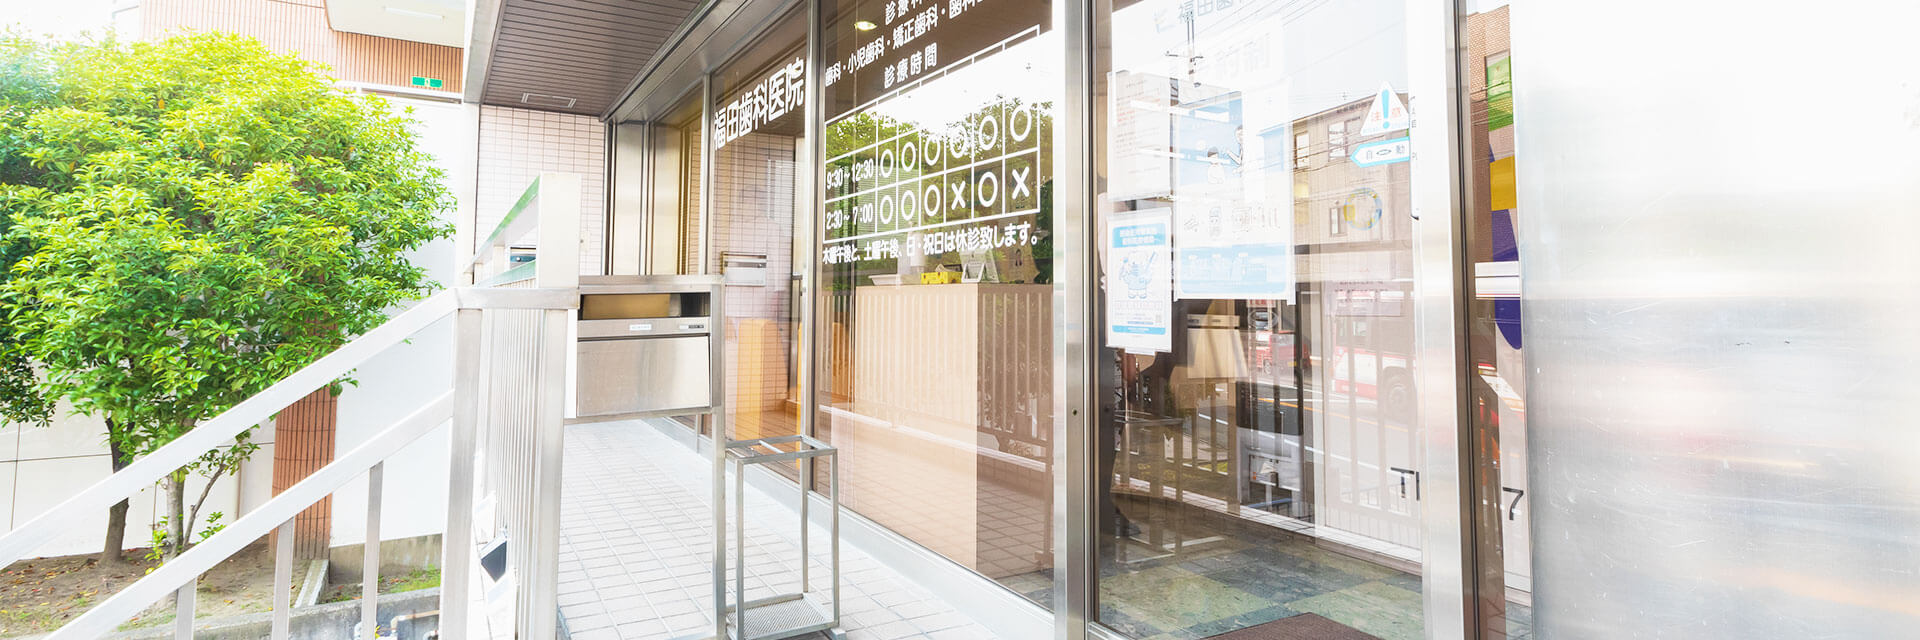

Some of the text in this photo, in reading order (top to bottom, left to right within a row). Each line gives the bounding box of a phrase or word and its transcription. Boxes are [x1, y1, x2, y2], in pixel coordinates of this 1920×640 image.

[884, 43, 937, 88] 診療時間
[714, 57, 804, 151] 福田歯科医院
